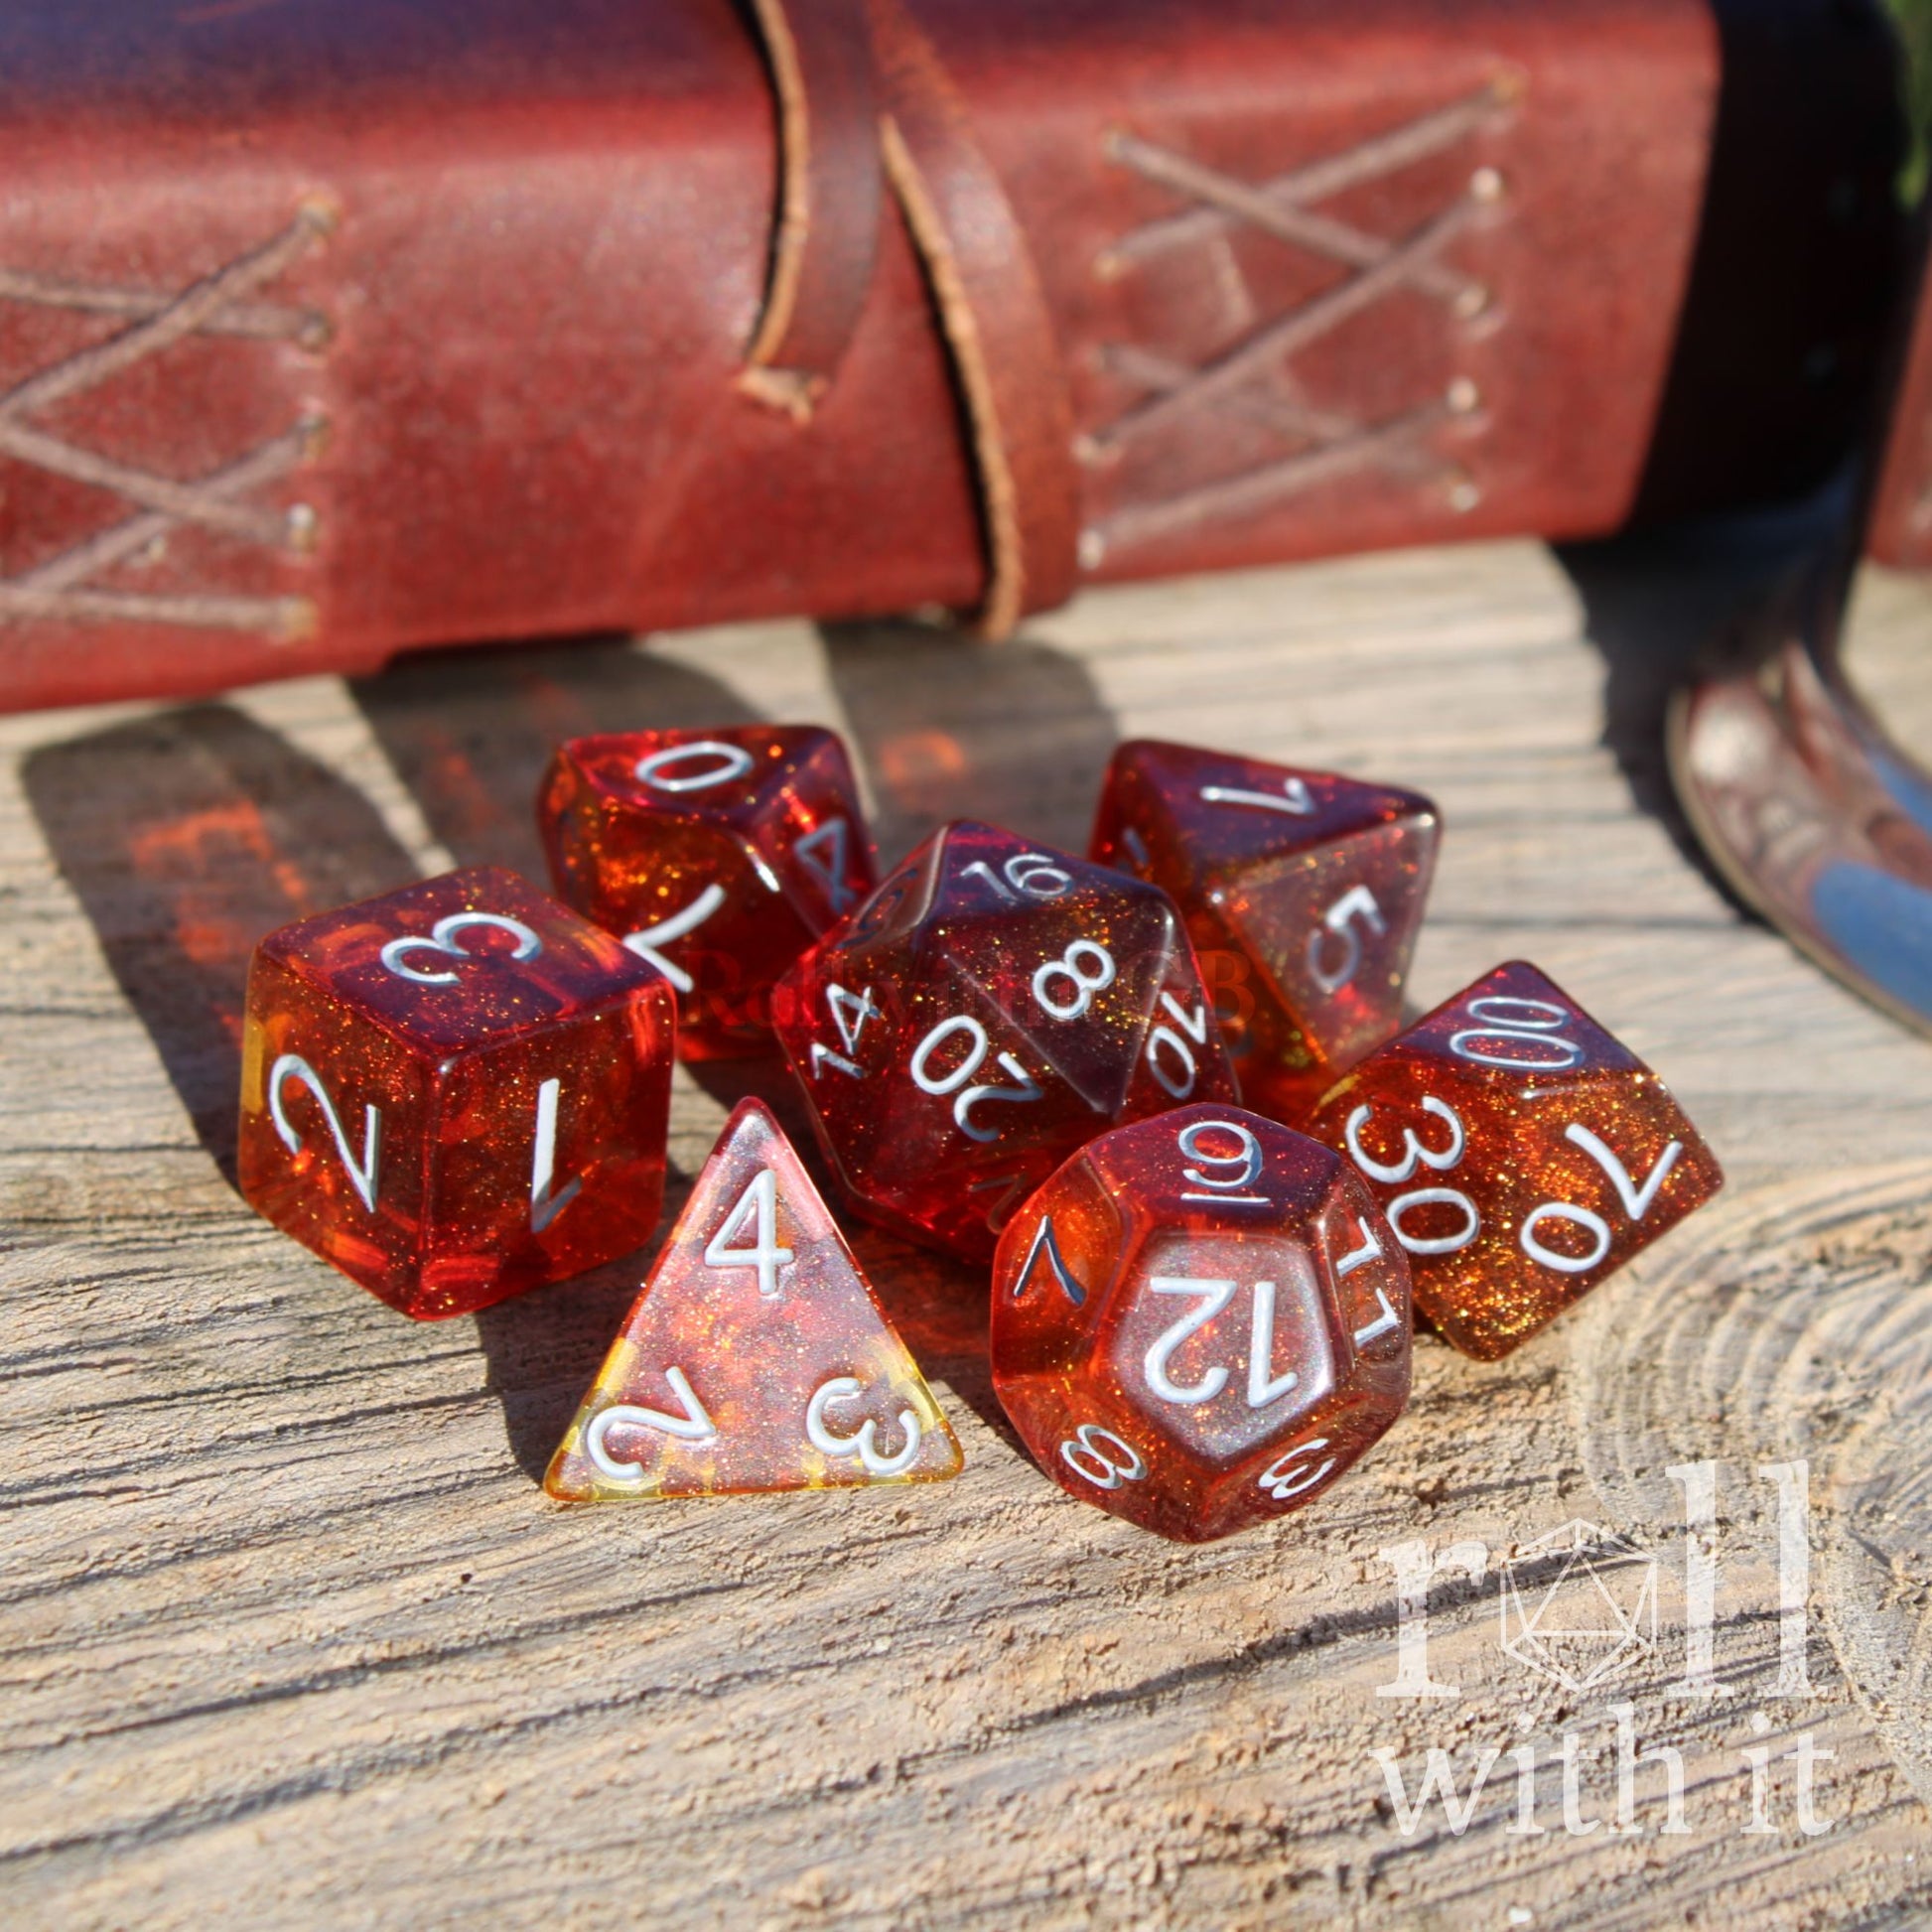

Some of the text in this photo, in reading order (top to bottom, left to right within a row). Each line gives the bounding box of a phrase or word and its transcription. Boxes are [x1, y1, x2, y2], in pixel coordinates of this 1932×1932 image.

[634, 741, 752, 791] 0
[794, 818, 856, 912] 4
[959, 853, 1073, 905] 16
[380, 912, 543, 985] 3
[1033, 939, 1116, 1021] 8
[1306, 885, 1386, 993] 5
[810, 981, 882, 1080] 14
[909, 1015, 1044, 1143] 20
[1146, 992, 1207, 1099] 10
[1449, 996, 1586, 1071] 00
[269, 1053, 381, 1213] 2
[530, 1077, 583, 1234] 1
[1344, 1095, 1480, 1256] 30
[704, 1169, 795, 1296] 4
[1519, 1123, 1683, 1275] 70
[1013, 1214, 1088, 1308] 7
[1144, 1276, 1299, 1409] 12
[587, 1365, 717, 1480] 2
[806, 1376, 921, 1477] 3
[1058, 1423, 1149, 1490] 8
[1257, 1437, 1338, 1500] 3
